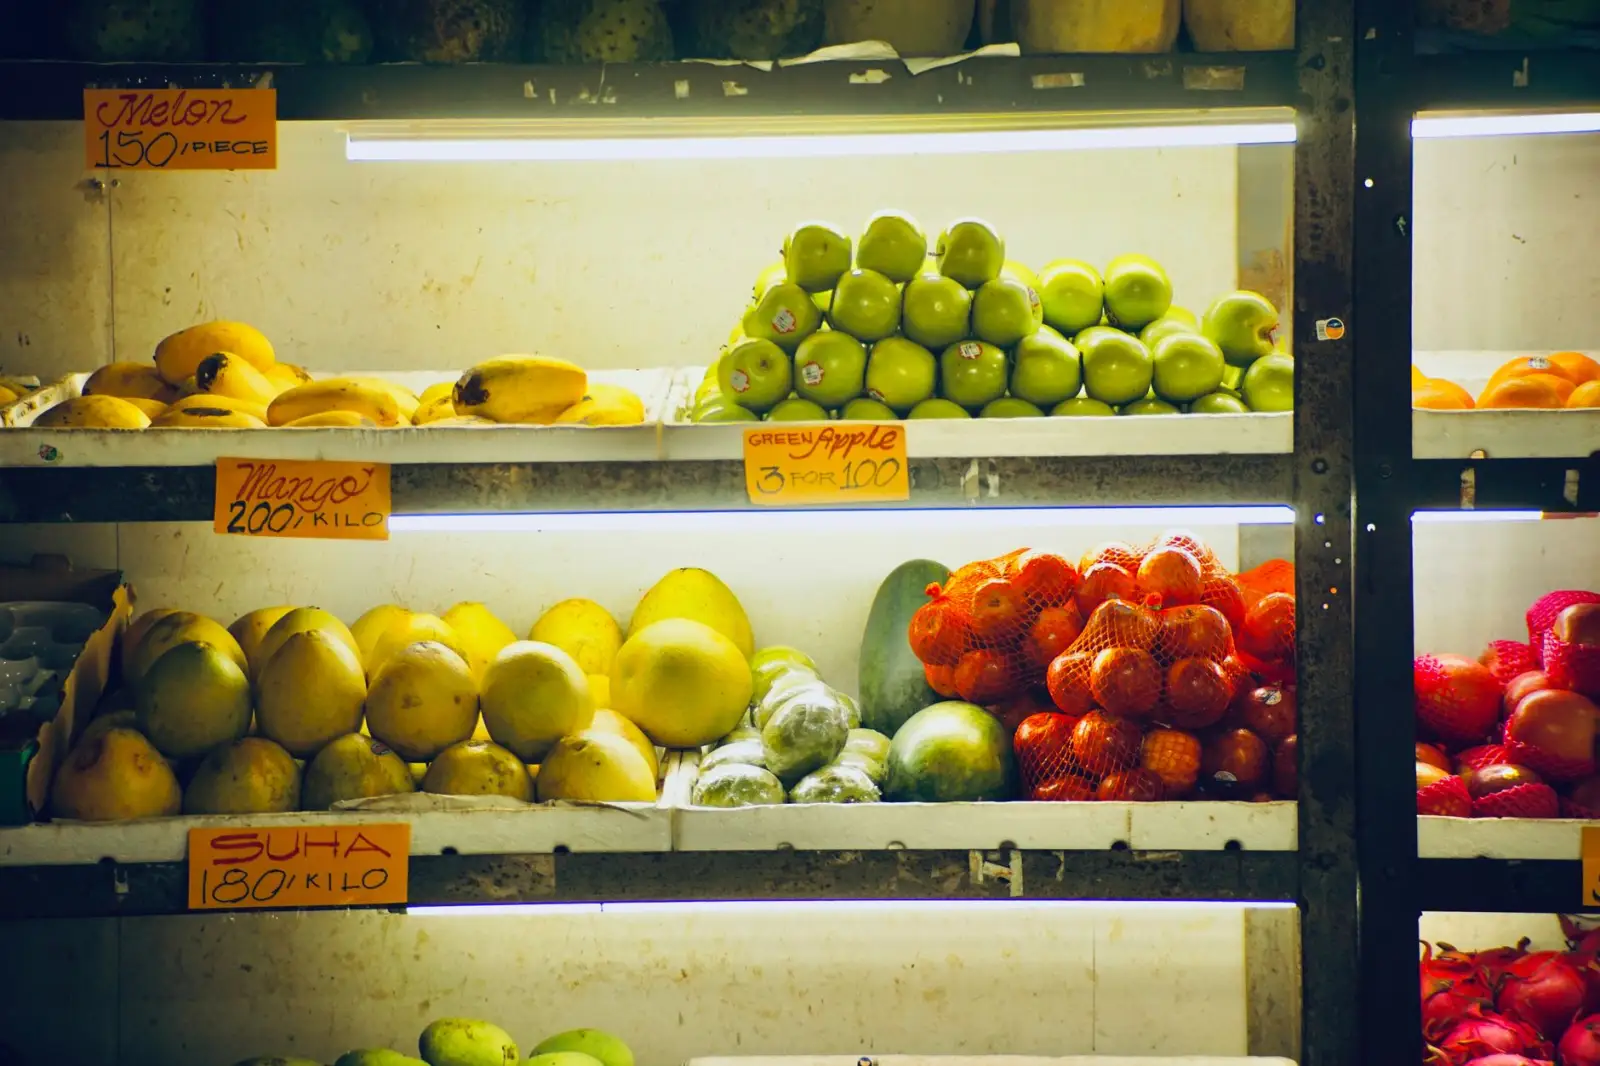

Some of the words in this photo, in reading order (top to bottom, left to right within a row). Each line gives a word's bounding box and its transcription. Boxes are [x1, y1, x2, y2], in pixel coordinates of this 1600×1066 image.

[97, 90, 247, 128] Melon
[749, 431, 813, 447] GREEN
[789, 425, 898, 460] Apple
[236, 463, 375, 513] Mango
[756, 466, 786, 494] 3
[790, 470, 837, 488] FOR
[839, 457, 900, 491] 100
[210, 829, 392, 866] SUHA
